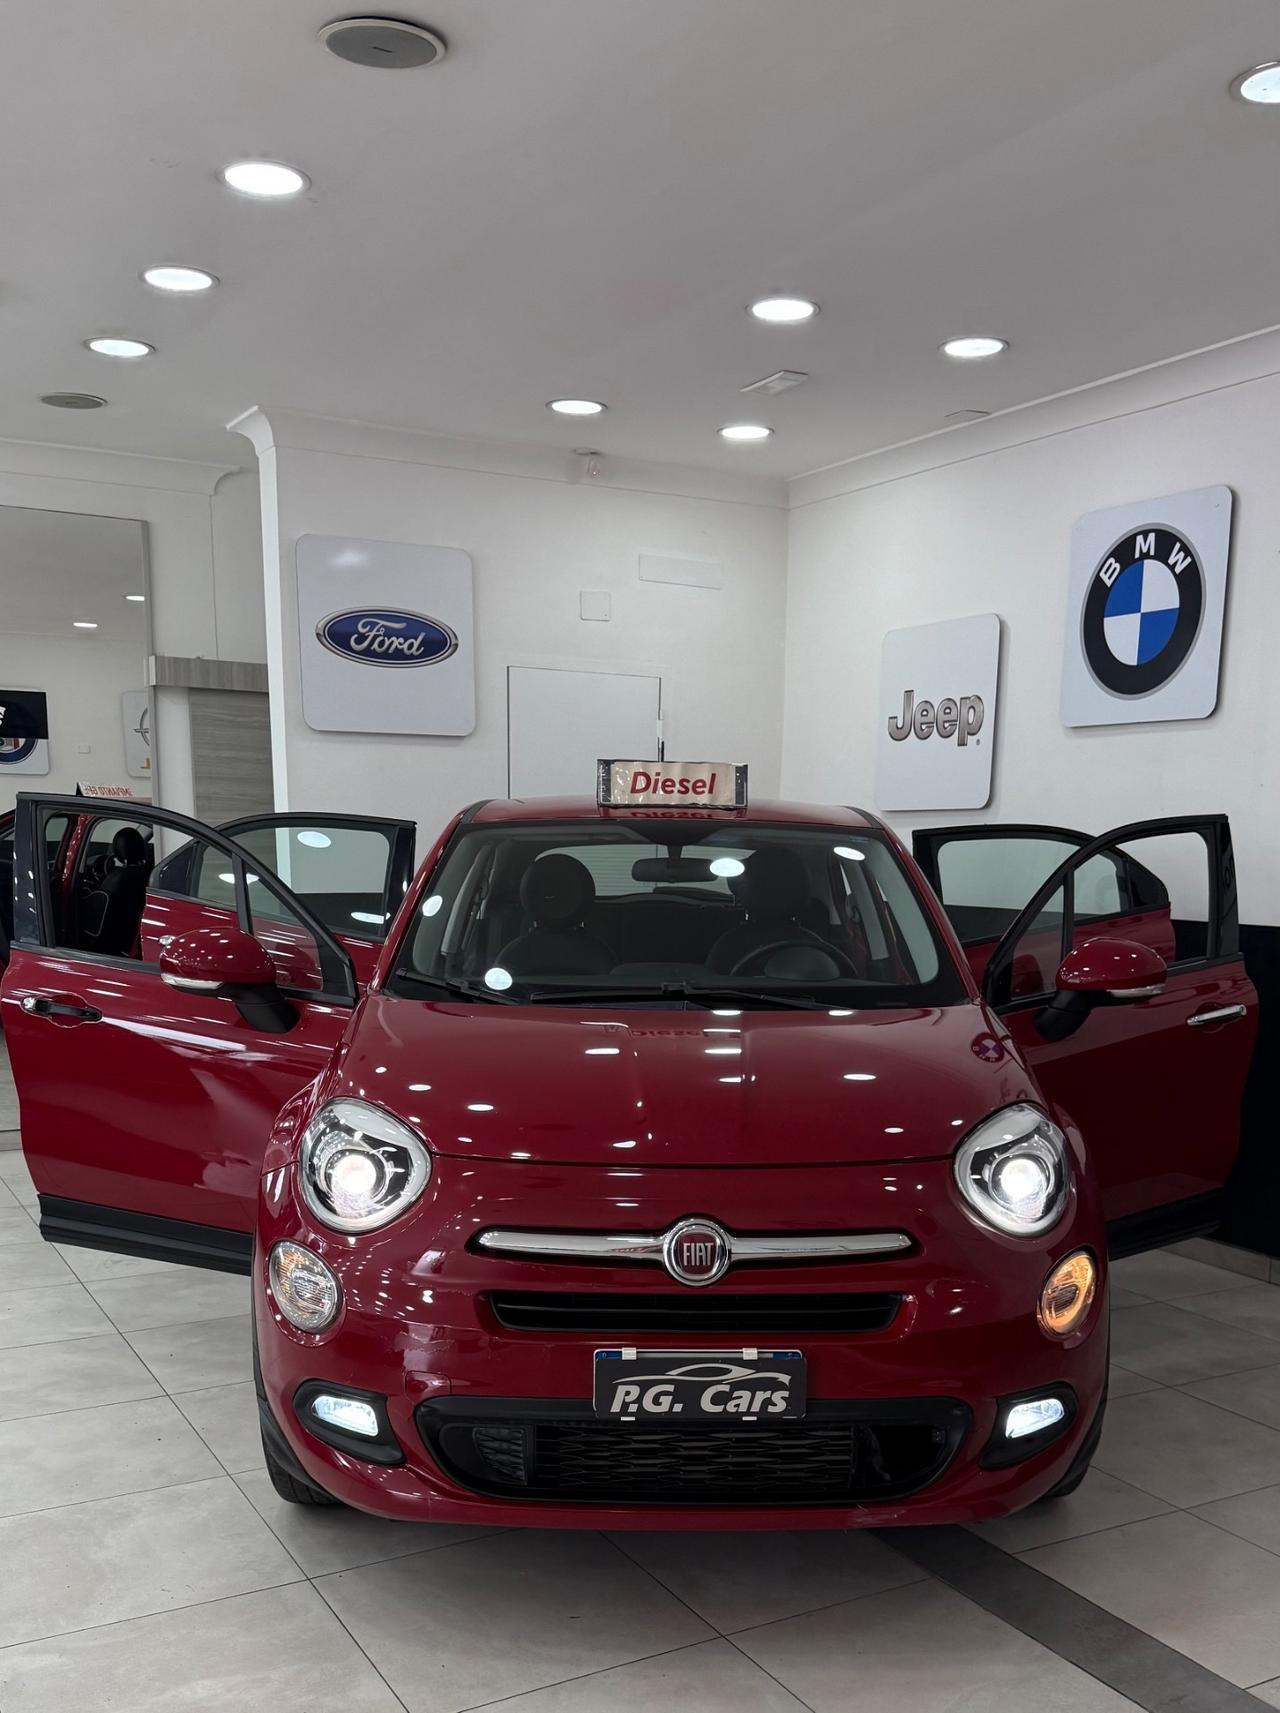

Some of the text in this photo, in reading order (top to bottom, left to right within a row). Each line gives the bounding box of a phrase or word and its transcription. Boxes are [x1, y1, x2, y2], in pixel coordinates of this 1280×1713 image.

[1099, 532, 1192, 587] BMW
[350, 617, 427, 656] Ford
[888, 689, 985, 747] Jeep
[630, 771, 717, 795] Diesel
[683, 1242, 714, 1266] FIAT
[610, 1384, 790, 1413] P.G. Cars
